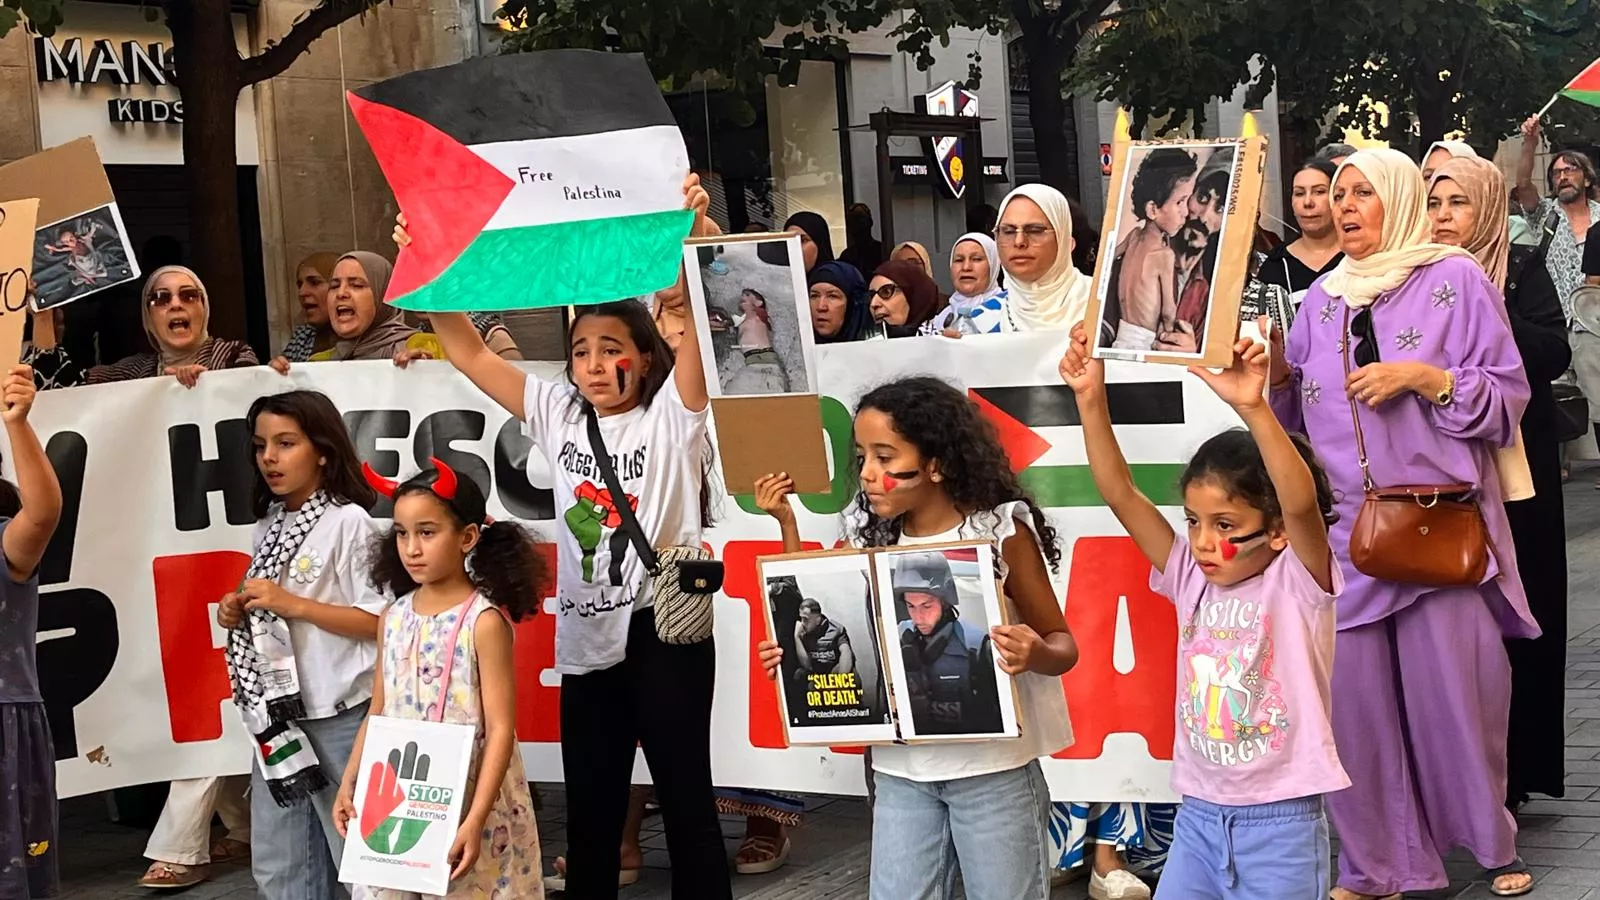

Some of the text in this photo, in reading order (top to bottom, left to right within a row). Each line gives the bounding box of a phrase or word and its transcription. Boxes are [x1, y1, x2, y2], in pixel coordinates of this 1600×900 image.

[35, 37, 177, 84] MAN
[518, 166, 553, 183] Free
[902, 164, 927, 175] TICKETING
[563, 185, 622, 200] Palestina
[807, 691, 822, 706] OR
[1190, 732, 1269, 765] ENERGY
[410, 785, 451, 804] STOP
[406, 809, 447, 821] PALESTINO
